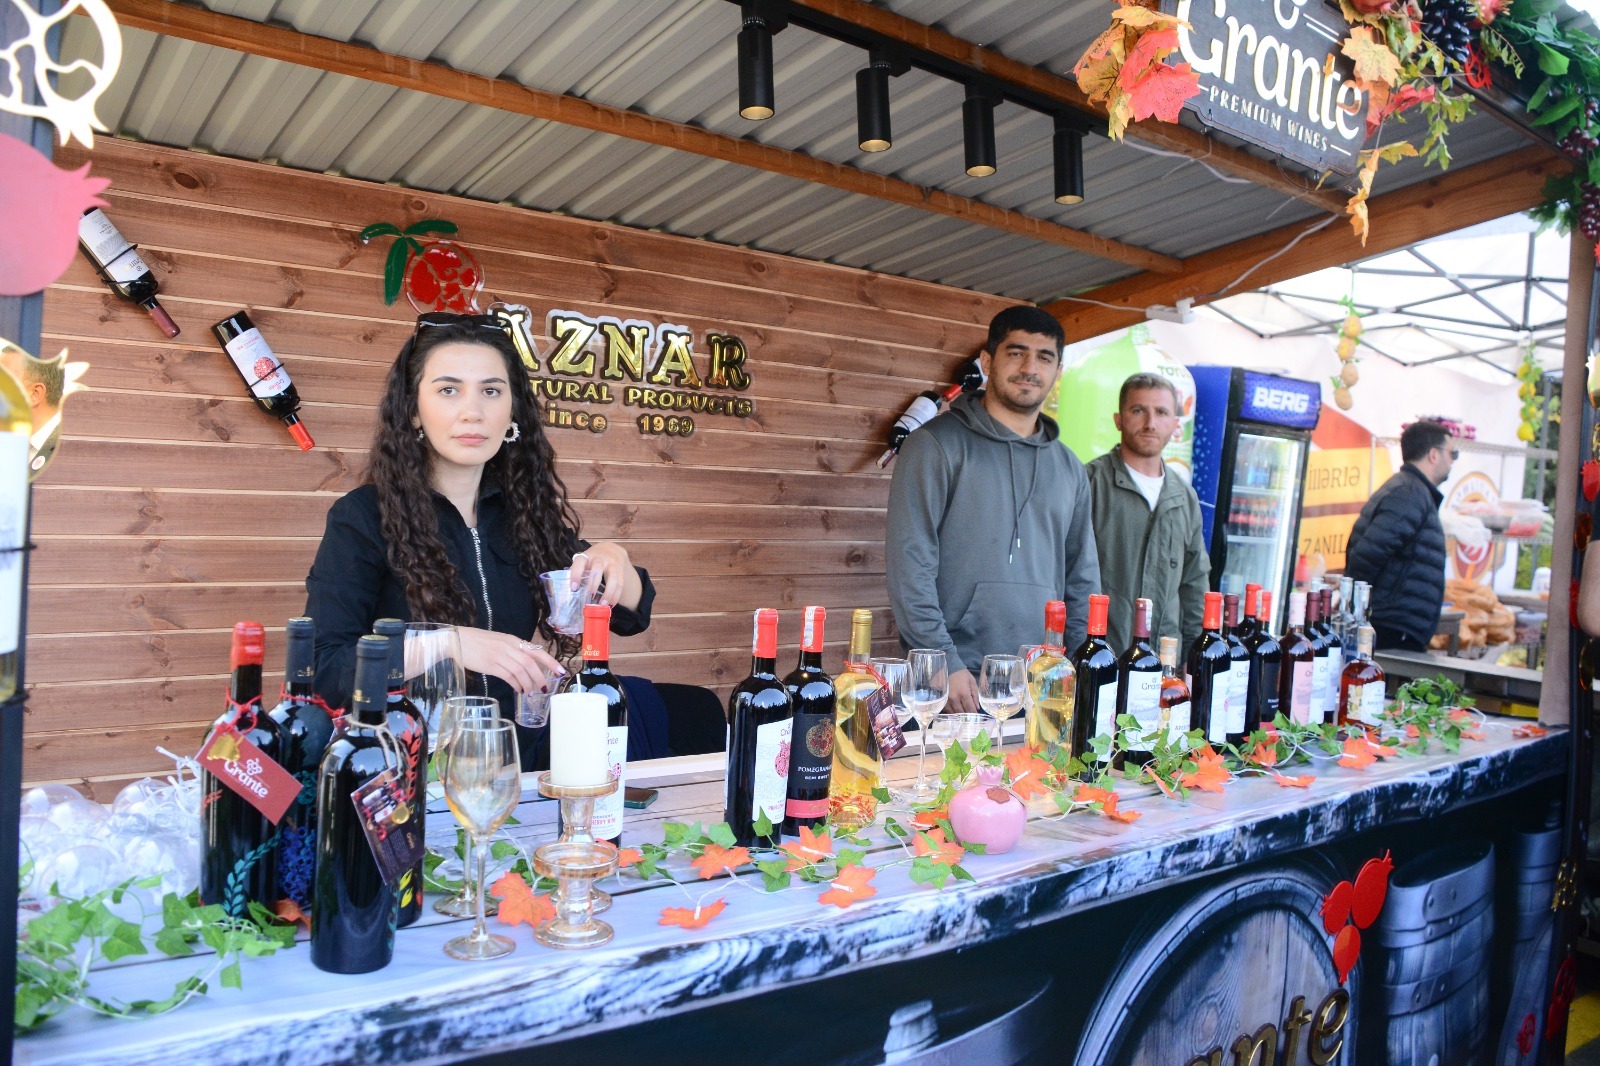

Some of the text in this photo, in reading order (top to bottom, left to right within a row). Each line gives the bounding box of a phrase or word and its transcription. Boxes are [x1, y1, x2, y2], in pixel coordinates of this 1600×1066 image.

[1177, 0, 1363, 140] Grante
[1209, 85, 1328, 152] PREMIUM WINES
[529, 379, 752, 415] TURAL PRODUCTS
[1252, 386, 1310, 413] BERG
[548, 402, 693, 434] ince 1969
[224, 758, 269, 798] Grante
